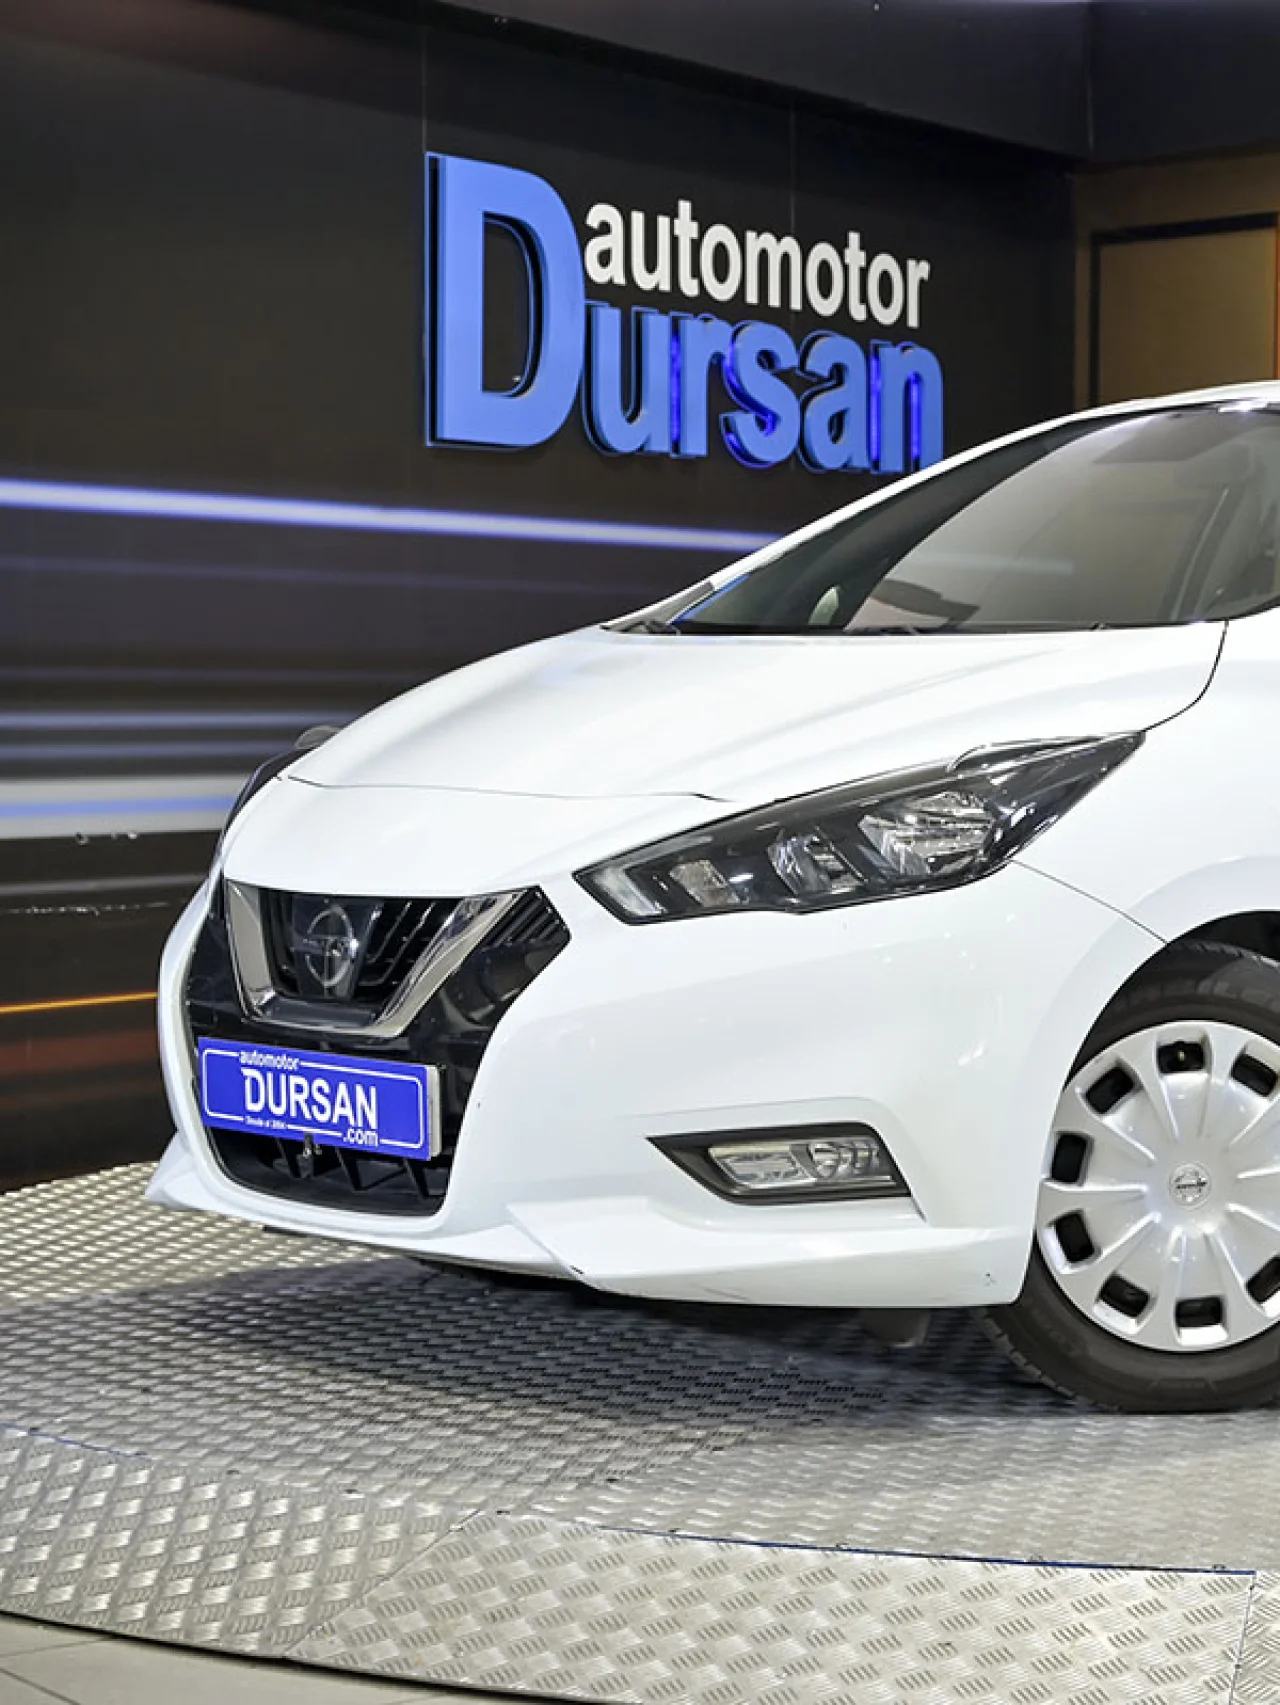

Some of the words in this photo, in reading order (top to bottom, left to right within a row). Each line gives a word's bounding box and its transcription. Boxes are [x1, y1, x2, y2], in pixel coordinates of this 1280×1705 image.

[584, 199, 930, 328] automotor
[425, 151, 944, 475] Dursan
[240, 1050, 299, 1070] automotor
[241, 1067, 377, 1129] DURSAN
[343, 1128, 379, 1147] .com
